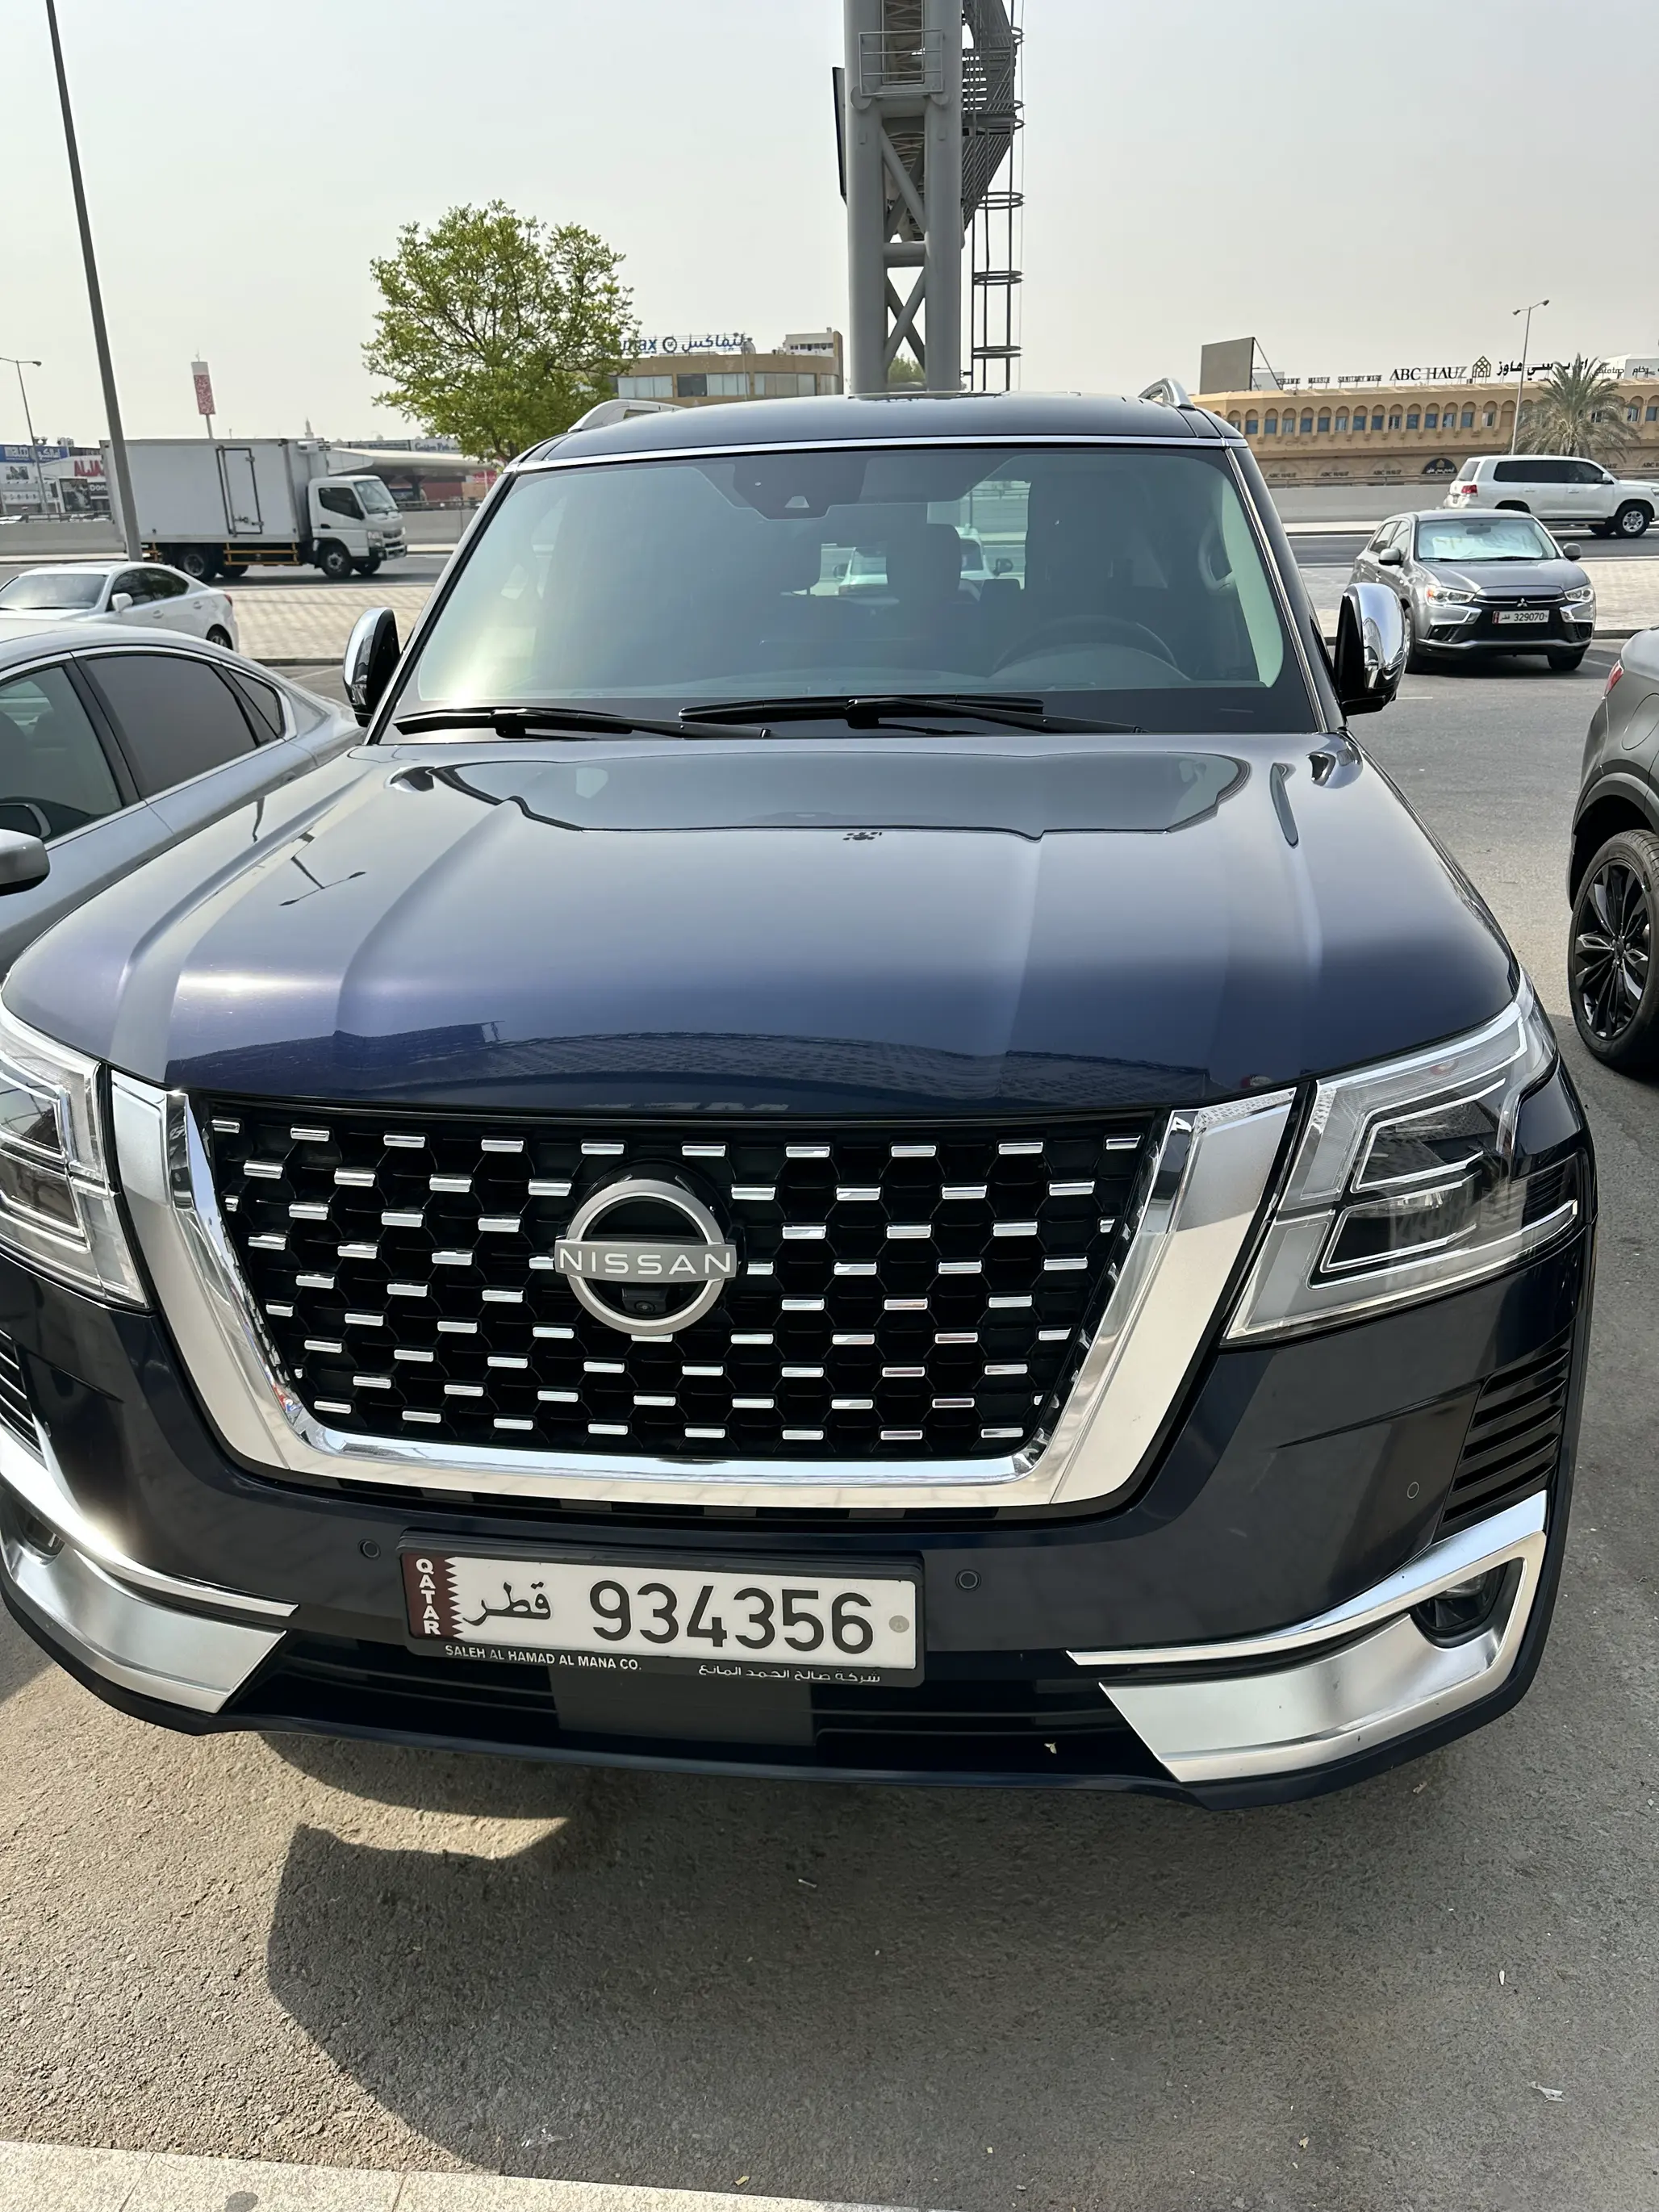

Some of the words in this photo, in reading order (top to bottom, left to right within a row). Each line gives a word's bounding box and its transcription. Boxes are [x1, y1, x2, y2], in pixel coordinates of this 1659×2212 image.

[1389, 368, 1421, 381] ABC
[1427, 366, 1468, 379] HAUZ
[1514, 613, 1544, 621] 329070
[559, 1248, 730, 1275] NISSAN
[416, 1558, 441, 1635] QATAR
[462, 1581, 551, 1626] قطر
[589, 1579, 874, 1654] 934356
[445, 1645, 486, 1659] SALEH
[490, 1649, 505, 1661] AL
[508, 1650, 555, 1664] HAMAD
[559, 1654, 575, 1666] AL
[578, 1655, 616, 1670] MANA
[620, 1658, 642, 1670] CO.
[699, 1664, 742, 1676] المانع
[746, 1669, 790, 1679] الحمد
[794, 1670, 831, 1681] صالح
[834, 1670, 880, 1683] شركة
